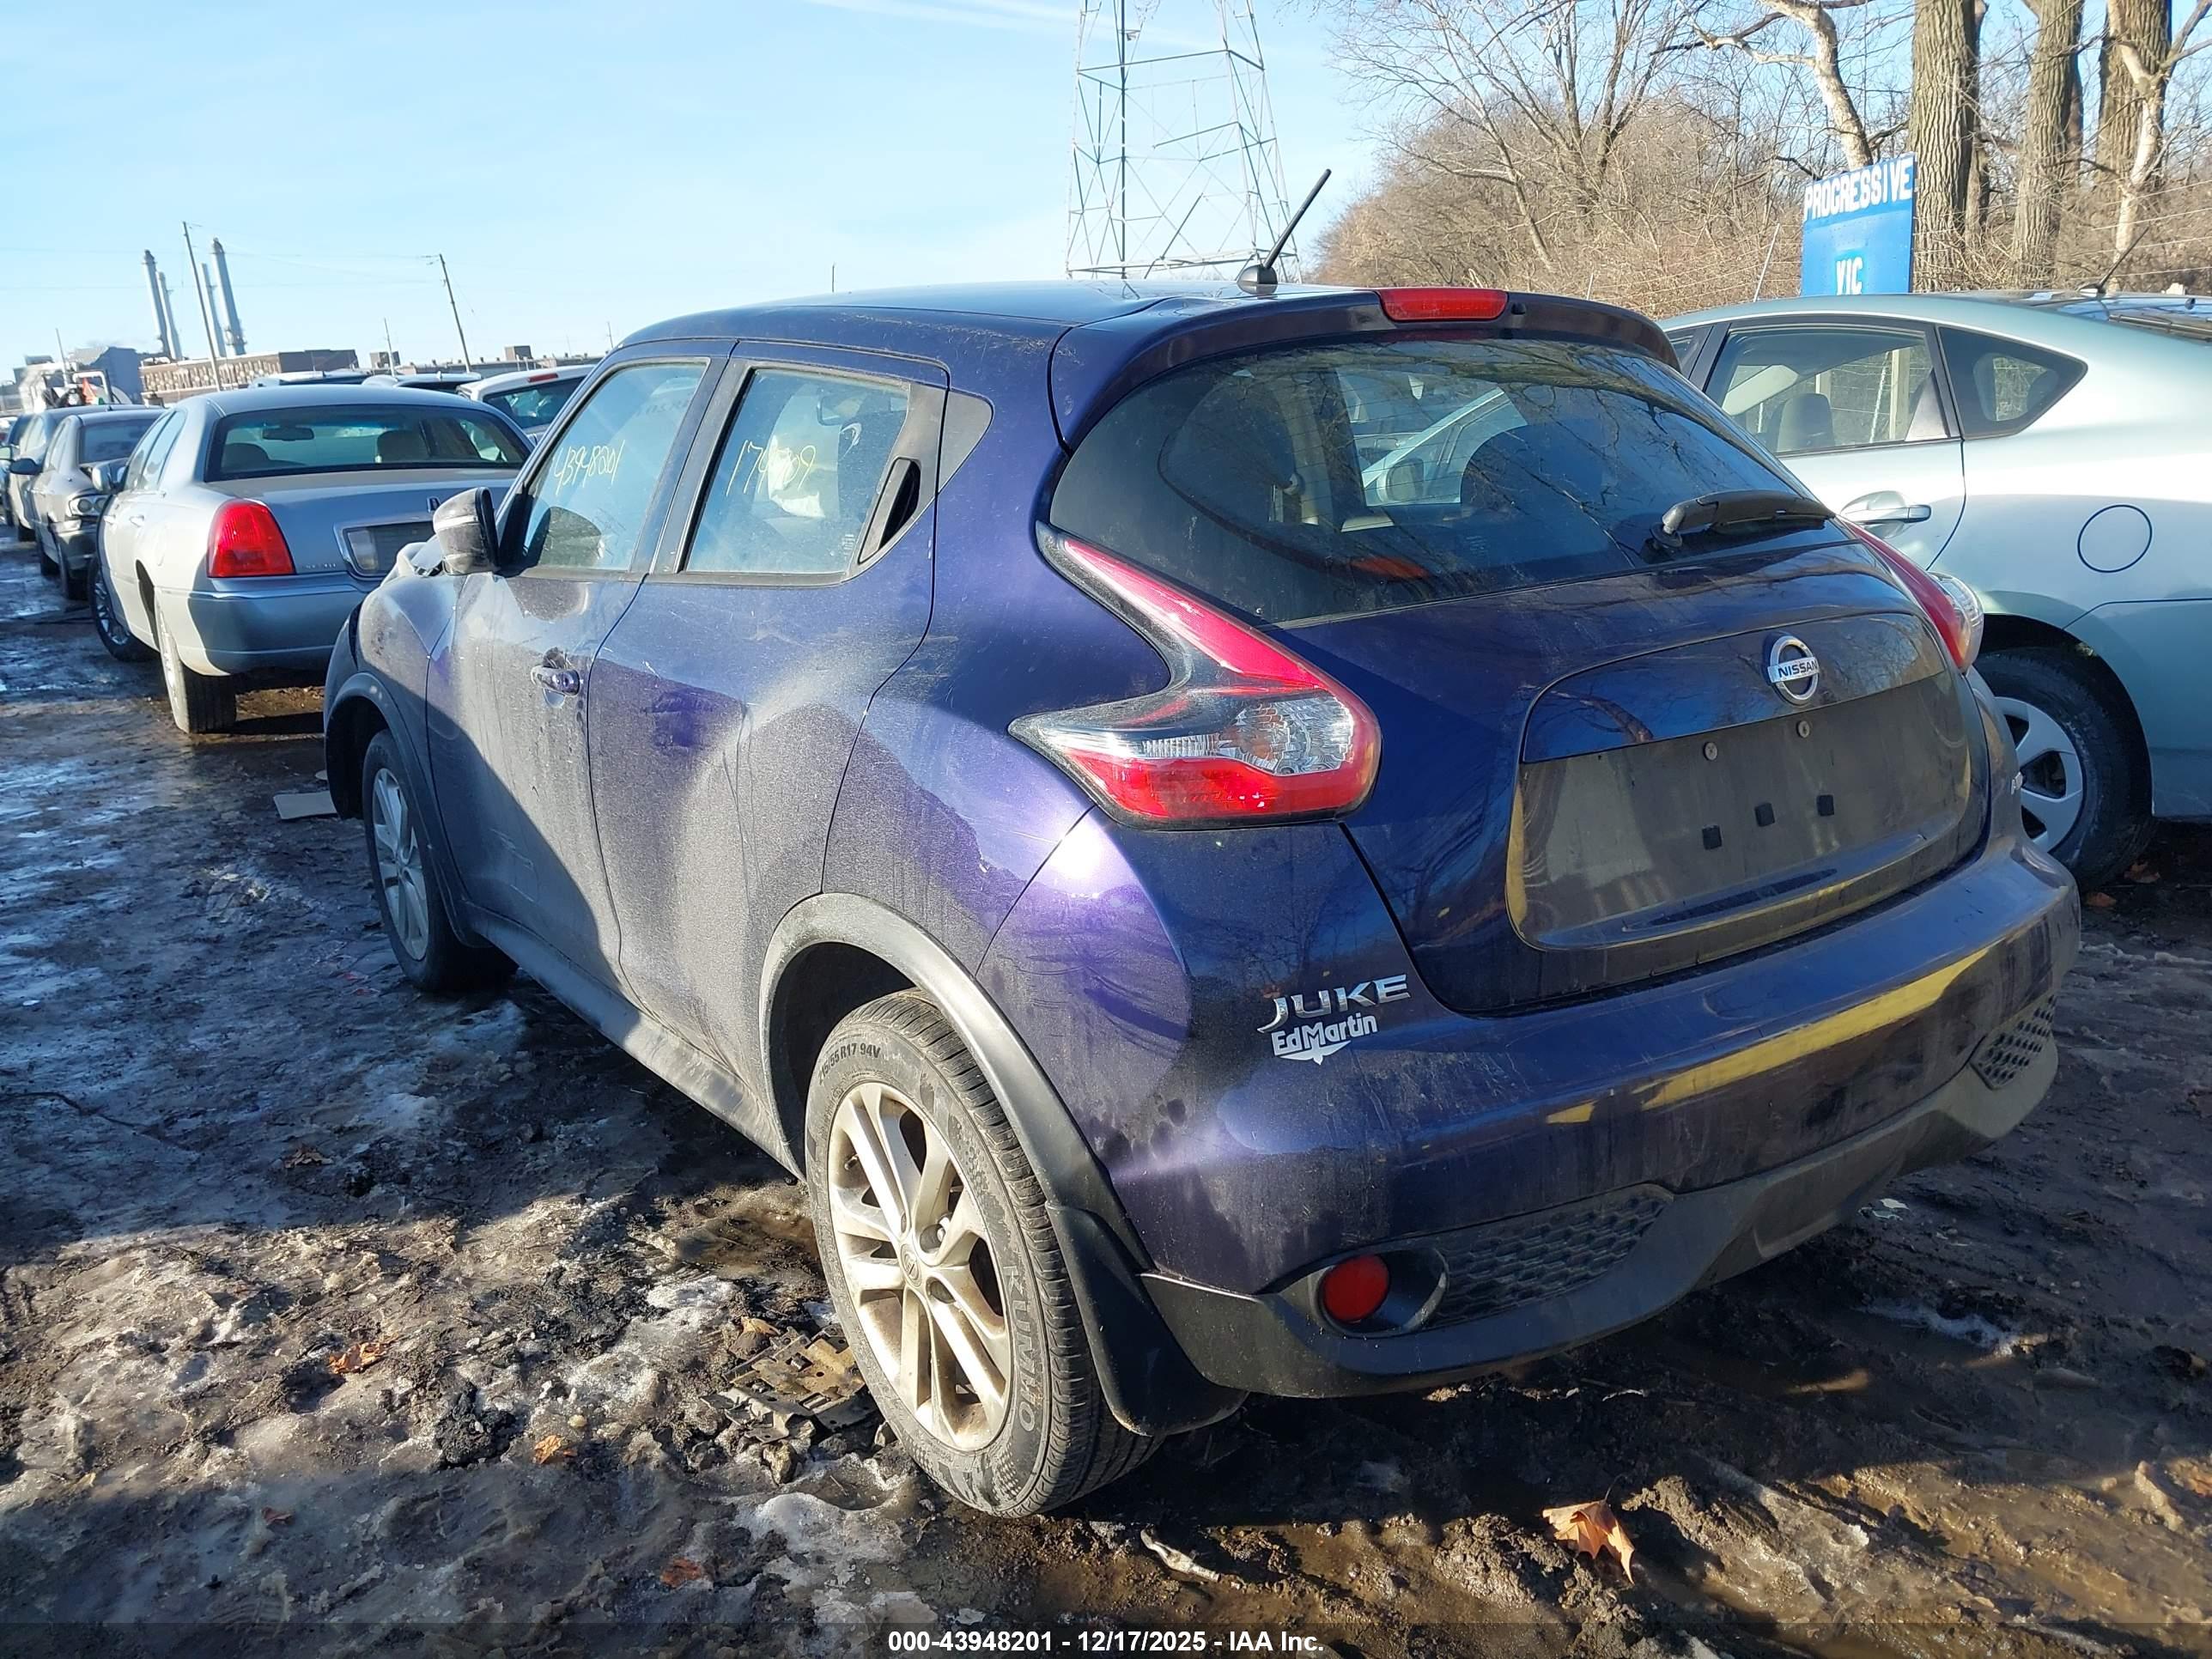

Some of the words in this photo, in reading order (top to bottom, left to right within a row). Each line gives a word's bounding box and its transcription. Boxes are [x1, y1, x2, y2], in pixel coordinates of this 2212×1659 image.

[1803, 157, 1913, 222] PROGRESSIVE
[554, 439, 625, 495] 43948201
[1778, 661, 1818, 678] NISSAN
[1257, 974, 1411, 1033] JUKE
[841, 1042, 858, 1060] R17
[860, 1042, 881, 1059] 94V
[1271, 1012, 1378, 1056] EdMartin
